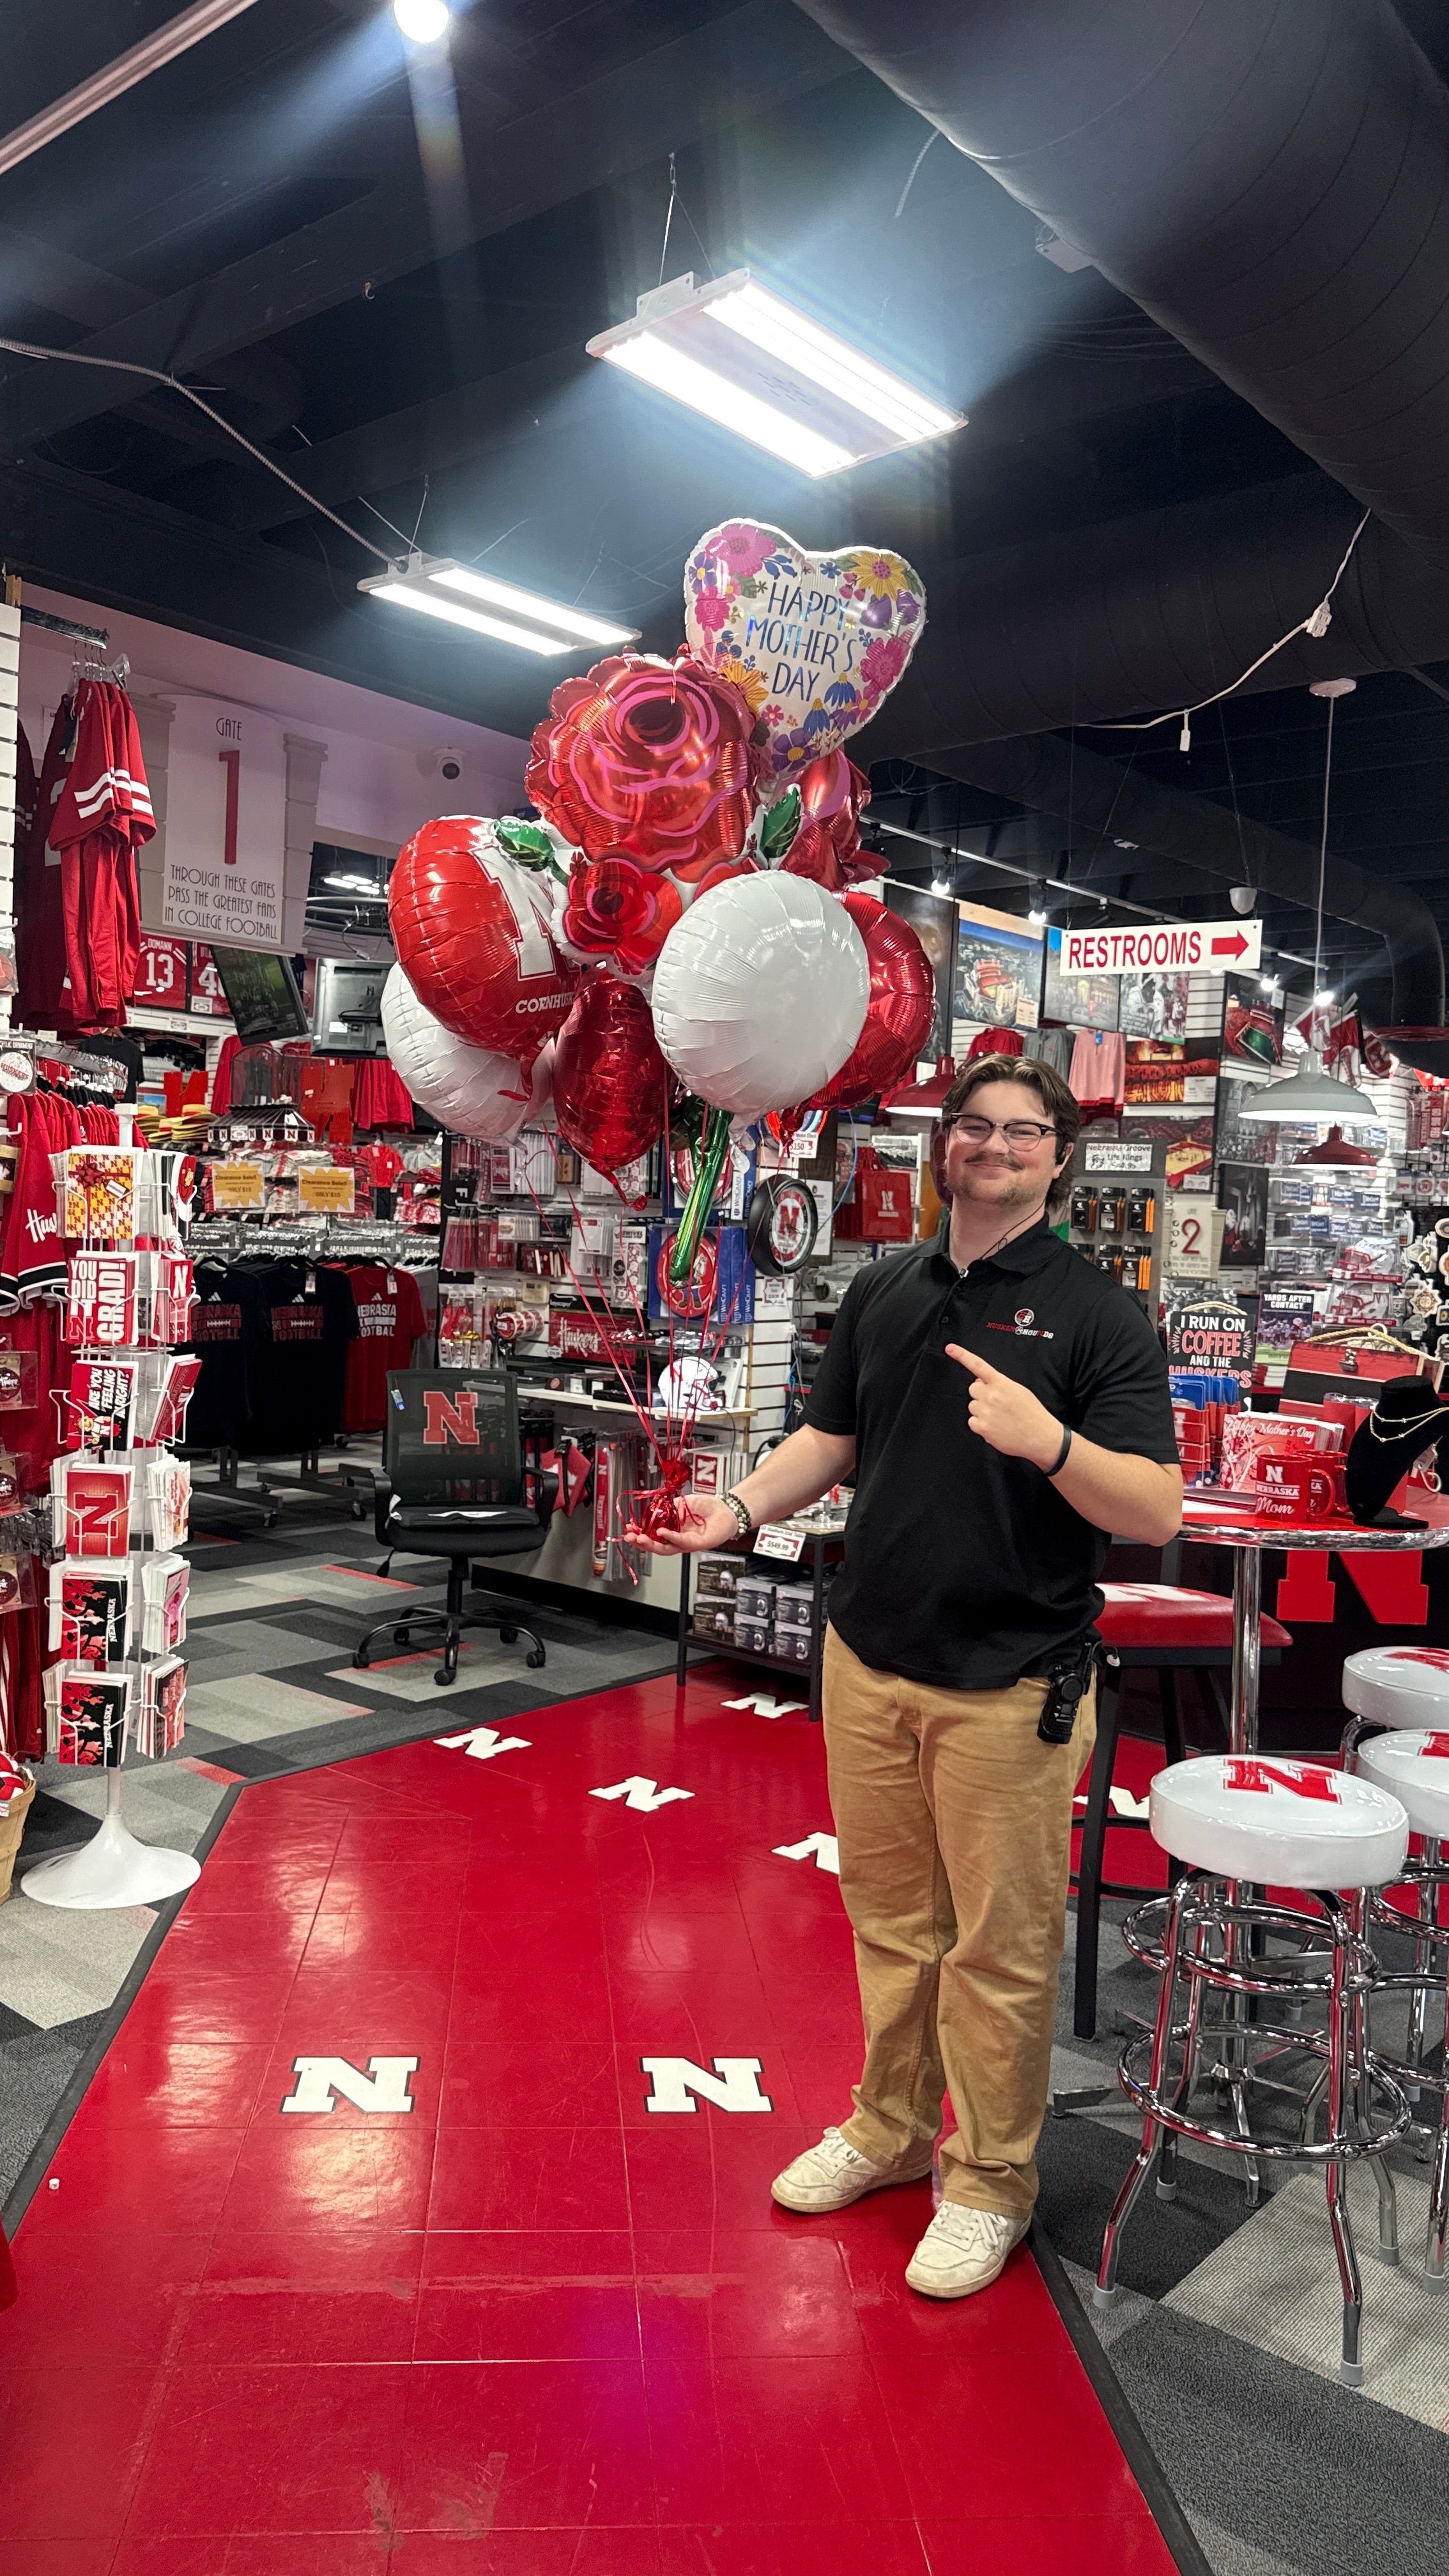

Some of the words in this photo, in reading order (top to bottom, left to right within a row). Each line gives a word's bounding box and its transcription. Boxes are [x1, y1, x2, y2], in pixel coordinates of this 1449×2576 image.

[767, 582, 850, 631] HAPPY
[746, 615, 858, 673] MOTHER'S
[772, 662, 820, 702] DAY
[215, 717, 242, 740] GATE
[218, 749, 240, 865] 1
[171, 864, 220, 889] THROUGH
[225, 874, 247, 894] THESE
[251, 880, 275, 898] GATES
[168, 885, 190, 903] PASS
[194, 890, 208, 907] THE
[213, 894, 252, 915] GREATEST
[257, 901, 276, 919] FANS
[165, 906, 173, 922] IN
[178, 909, 221, 930] COLLEGE
[226, 919, 277, 939] FOOTBALL
[148, 938, 172, 951] DOMANN
[1069, 930, 1201, 969] RESTROOMS
[146, 951, 174, 988] 13
[287, 1130, 296, 1139] N
[1123, 1153, 1142, 1162] Rings
[1181, 1218, 1201, 1255] 2
[70, 1259, 96, 1280] YOU
[173, 1265, 188, 1299] N
[71, 1280, 96, 1300] DID
[96, 1261, 126, 1340] GRAD!
[1264, 1294, 1287, 1302] YARDS
[1288, 1294, 1312, 1303] AFTER
[70, 1298, 96, 1317] IT
[271, 1305, 324, 1319] NEBRASKA
[70, 1316, 94, 1340] N
[557, 1317, 602, 1358] Huskers
[986, 1322, 1015, 1333] HUSKER
[1022, 1328, 1054, 1339] HOUNDS
[1181, 1315, 1185, 1328] I
[1189, 1315, 1219, 1330] RUN
[1223, 1317, 1246, 1332] ON
[1182, 1330, 1241, 1357] COFFEE
[1190, 1354, 1210, 1367] AND
[1213, 1356, 1232, 1368] THE
[90, 1367, 103, 1388] YOU
[101, 1369, 116, 1409] FEELING
[88, 1389, 100, 1411] ARE
[424, 1391, 479, 1445] N
[1226, 1419, 1256, 1438] Happy
[1259, 1423, 1294, 1437] Mother's
[1296, 1425, 1315, 1444] Day
[697, 1459, 717, 1483] N
[1266, 1465, 1284, 1483] N
[1256, 1485, 1300, 1496] NEBRASKA
[73, 1492, 119, 1539] N
[1257, 1497, 1294, 1514] Mom
[767, 1526, 784, 1535] Stadium
[106, 1597, 118, 1643] NEBRASKA
[720, 1692, 809, 1719] N
[103, 1703, 114, 1749] NEBRASKA
[433, 1728, 533, 1759] N
[588, 1775, 696, 1813] N
[1222, 1758, 1344, 1805] N
[279, 2055, 421, 2113] N
[640, 2056, 774, 2113] N
